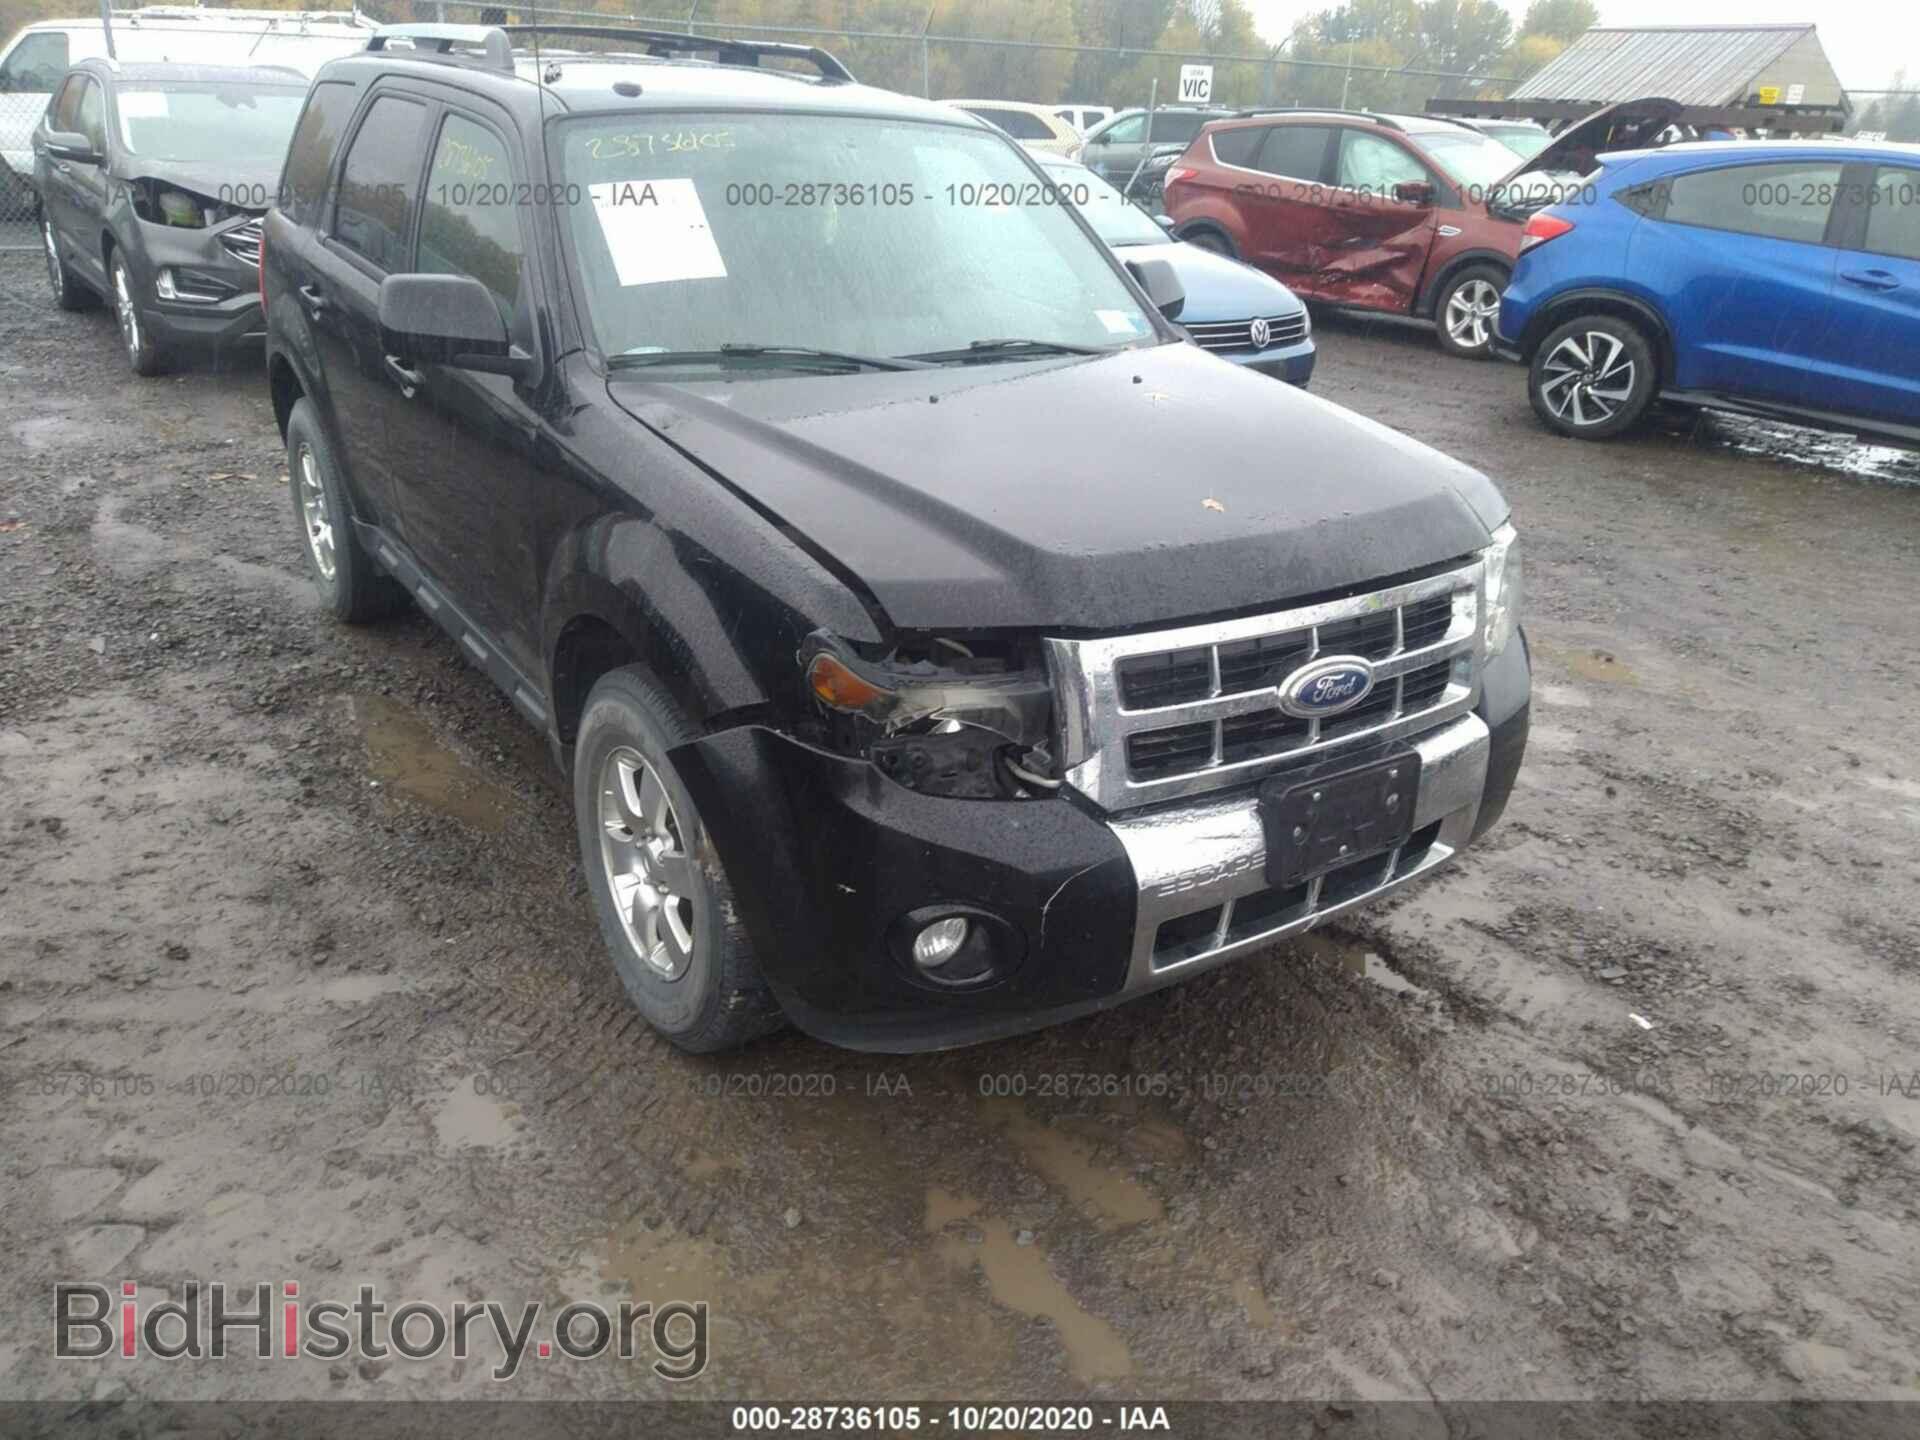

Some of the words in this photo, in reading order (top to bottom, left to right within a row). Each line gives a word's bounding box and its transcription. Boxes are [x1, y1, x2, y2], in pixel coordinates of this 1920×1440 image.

[1183, 79, 1209, 98] VIC
[1312, 672, 1357, 703] Ford
[1157, 850, 1266, 897] ESCAPE
